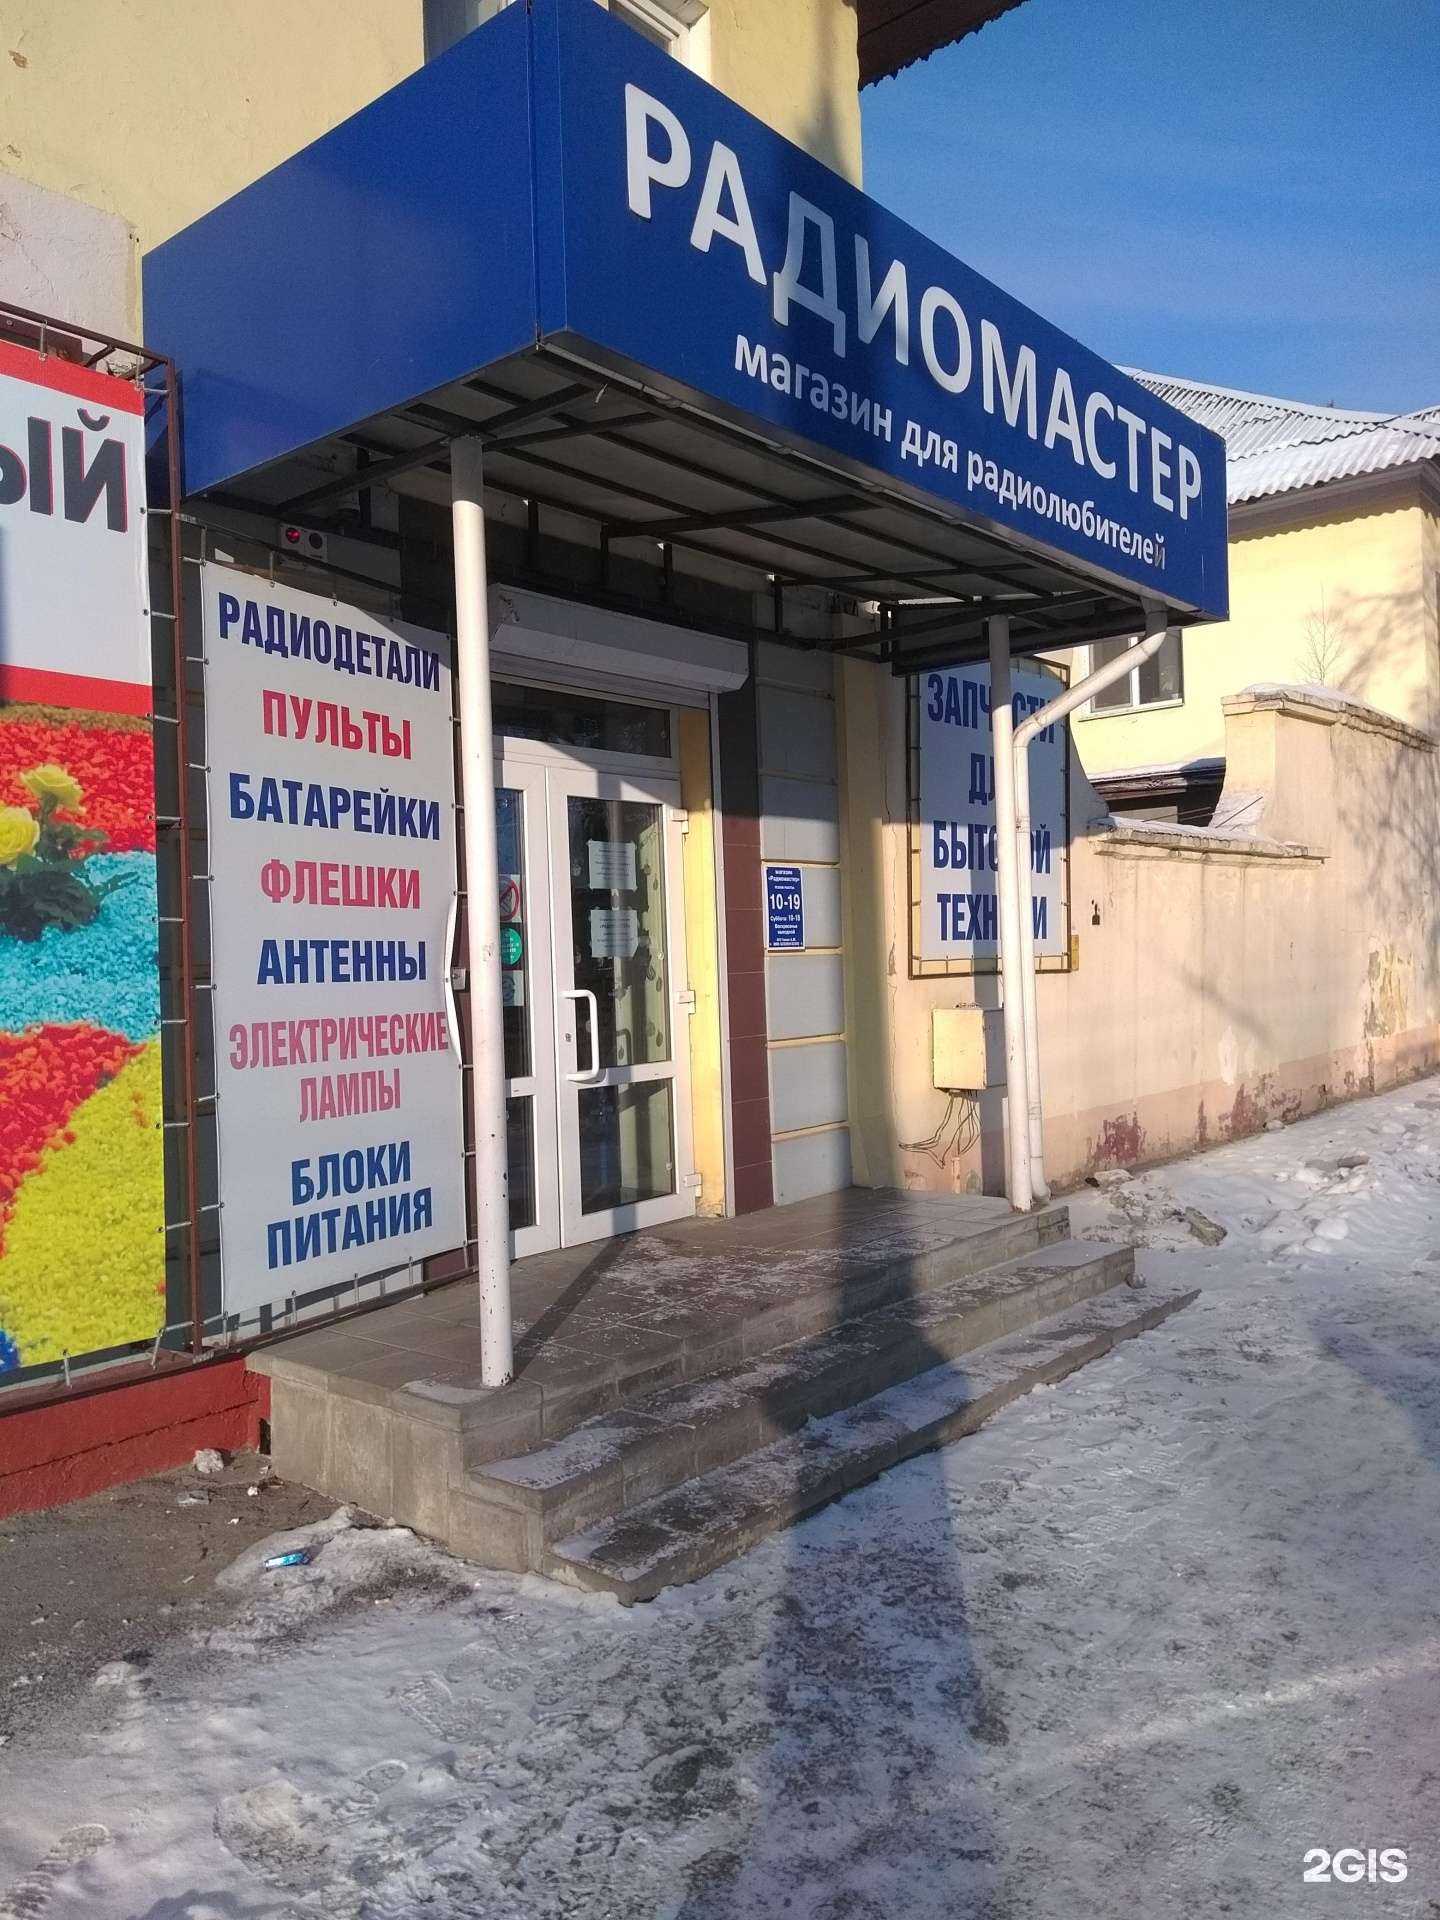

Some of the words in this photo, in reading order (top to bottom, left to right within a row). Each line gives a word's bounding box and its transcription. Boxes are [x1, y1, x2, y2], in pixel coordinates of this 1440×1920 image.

[625, 82, 1202, 520] РАДИОМАСТЕР
[734, 334, 893, 443] магазин
[900, 420, 958, 474] для
[967, 450, 1166, 570] радиолюбителей
[218, 591, 441, 692] РАДИОДЕТАЛИ
[262, 688, 412, 760] ПУЛЬТЫ
[228, 772, 441, 841] БАТАРЕЙКИ
[260, 858, 420, 909] ФЛЕШКИ
[770, 893, 801, 910] 10-19
[937, 893, 1048, 941] ТЕХНИ
[256, 939, 427, 985] АНТЕННЫ
[228, 1011, 449, 1070] ЭЛЕКТРИЧЕСКИЕ
[299, 1067, 401, 1123] ЛАМПЫ
[291, 1141, 410, 1206] БЛОКИ
[267, 1187, 433, 1270] ПИТАНИЯ
